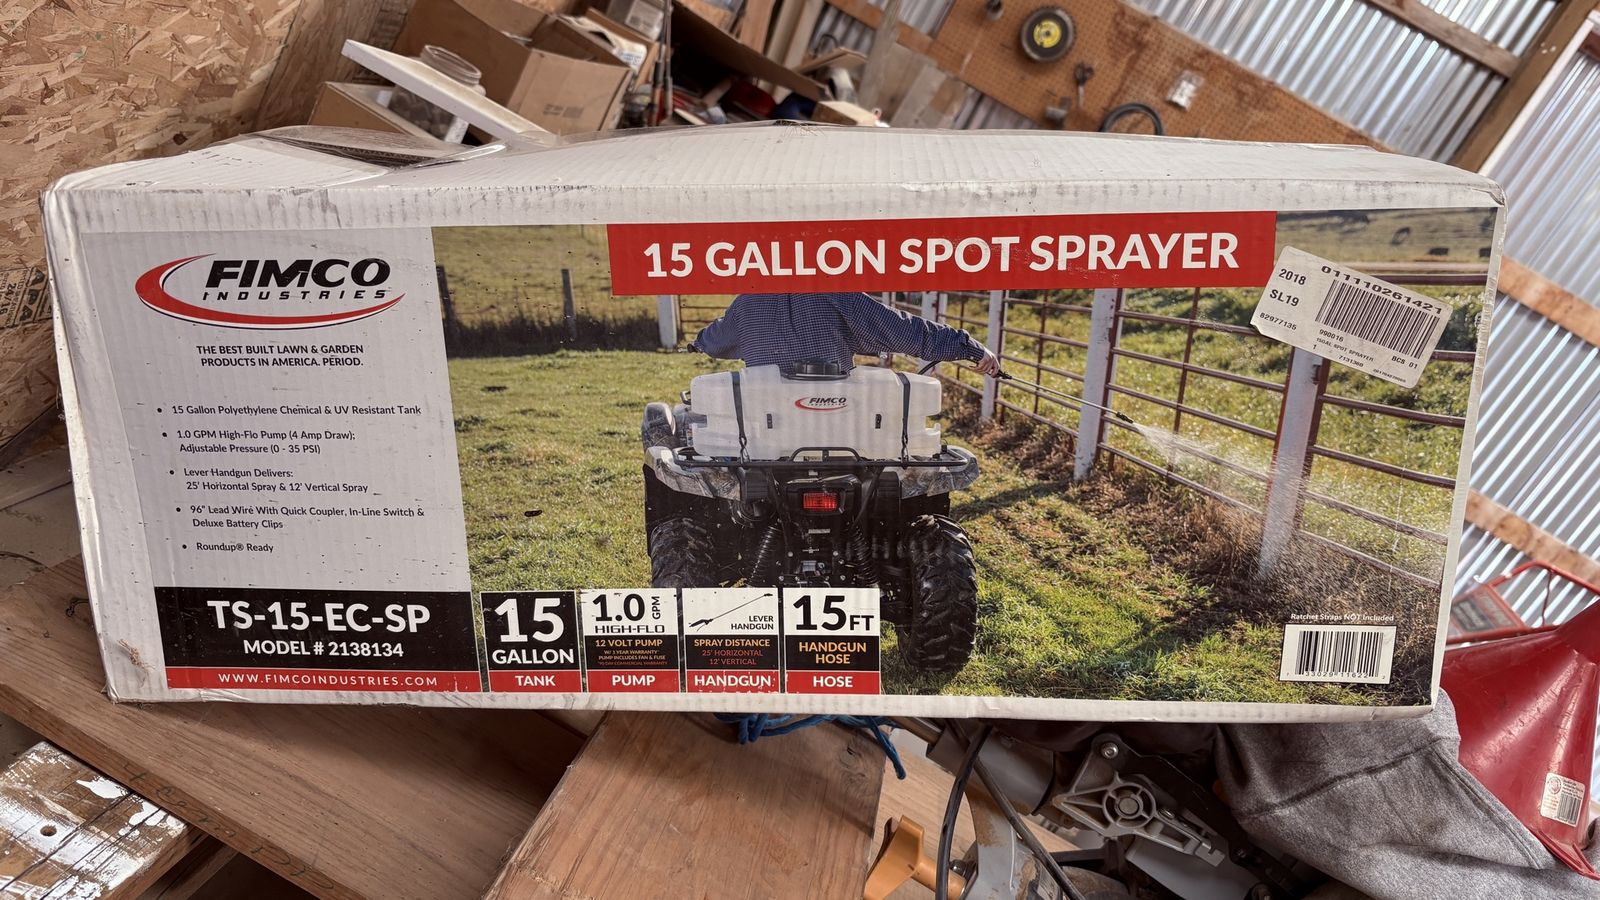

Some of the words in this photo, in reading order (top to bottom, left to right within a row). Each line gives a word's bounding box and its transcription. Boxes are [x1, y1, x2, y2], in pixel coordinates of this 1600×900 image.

[643, 243, 694, 278] 15
[705, 239, 887, 277] GALLON
[899, 235, 1020, 275] SPOT
[1028, 232, 1240, 272] SPRAYER
[205, 258, 391, 288] FIMCO
[1278, 268, 1306, 286] 2018
[202, 289, 388, 301] INDUSTRIES
[1322, 265, 1443, 315] 011110261421
[1269, 289, 1300, 307] SL19
[1259, 312, 1297, 331] 82977135
[196, 345, 217, 354] THE
[218, 345, 244, 354] BEST
[245, 345, 275, 354] BUILT
[276, 345, 310, 354] LAWN
[310, 345, 319, 354] &
[320, 345, 364, 354] GARDEN
[201, 357, 257, 367] PRODUCTS
[258, 357, 270, 367] IN
[271, 357, 321, 367] AMERICA.
[322, 357, 364, 367] PERIOD.
[1391, 355, 1406, 365] BCS
[1408, 361, 1418, 369] 01
[172, 405, 184, 415] 15
[186, 405, 217, 415] Gallon
[218, 405, 278, 418] Polyethylene
[279, 405, 323, 415] Chemical
[324, 405, 332, 415] &
[334, 405, 350, 415] UV
[352, 405, 396, 415] Resistant
[397, 405, 422, 415] Tank
[177, 430, 191, 440] 1.0
[193, 430, 217, 440] GPM
[219, 430, 259, 440] High-Flo
[260, 430, 287, 440] Pump
[288, 430, 299, 440] (4
[300, 430, 323, 440] Amp
[324, 430, 356, 440] Draw);
[179, 444, 228, 454] Adjustable
[229, 444, 269, 454] Pressure
[270, 444, 280, 454] (0
[288, 444, 301, 454] 35
[302, 444, 321, 454] PSI)
[184, 468, 209, 478] Lever
[210, 468, 252, 478] Handgun
[253, 468, 294, 478] Delivers:
[186, 482, 200, 491] 25'
[202, 482, 250, 491] Horizontal
[251, 482, 277, 492] Spray
[279, 482, 287, 492] &
[289, 483, 303, 492] 12'
[304, 483, 341, 492] Vertical
[342, 483, 368, 494] Spray
[190, 505, 206, 515] 96"
[208, 505, 230, 515] Lead
[231, 505, 254, 515] Wire
[255, 505, 279, 515] With
[280, 507, 307, 517] Quick
[309, 507, 347, 517] Coupler,
[349, 507, 381, 517] In-Line
[383, 507, 415, 517] Switch
[417, 507, 425, 517] &
[192, 519, 224, 528] Deluxe
[226, 519, 259, 530] Battery
[260, 519, 284, 530] Clips
[196, 542, 245, 553] Roundup®
[246, 542, 274, 553] Ready
[592, 593, 645, 622] 1.0
[651, 596, 661, 620] GPM
[207, 600, 431, 633] TS-15-EC-SP
[493, 597, 565, 643] 15
[1290, 613, 1318, 621] Ratchet
[1319, 613, 1342, 622] Straps
[1344, 613, 1361, 622] NOT
[1362, 614, 1394, 622] Included
[594, 625, 665, 634] HIGH-FLO
[243, 639, 311, 655] MODEL
[313, 640, 325, 656] #
[328, 641, 404, 657] 2138134
[595, 639, 606, 647] 12
[607, 639, 633, 647] VOLT
[635, 639, 663, 647] PUMP
[694, 639, 723, 647] SPRAY
[725, 639, 770, 647] DISTANCE
[798, 642, 867, 653] HANDGUN
[491, 648, 575, 665] GALLON
[815, 653, 851, 664] HOSE
[218, 673, 438, 687] WWW.FIMCOINDUSTRIES.COM
[515, 675, 556, 687] TANK
[612, 675, 656, 686] PUMP
[694, 675, 771, 687] HANDGUN
[812, 675, 854, 687] HOSE
